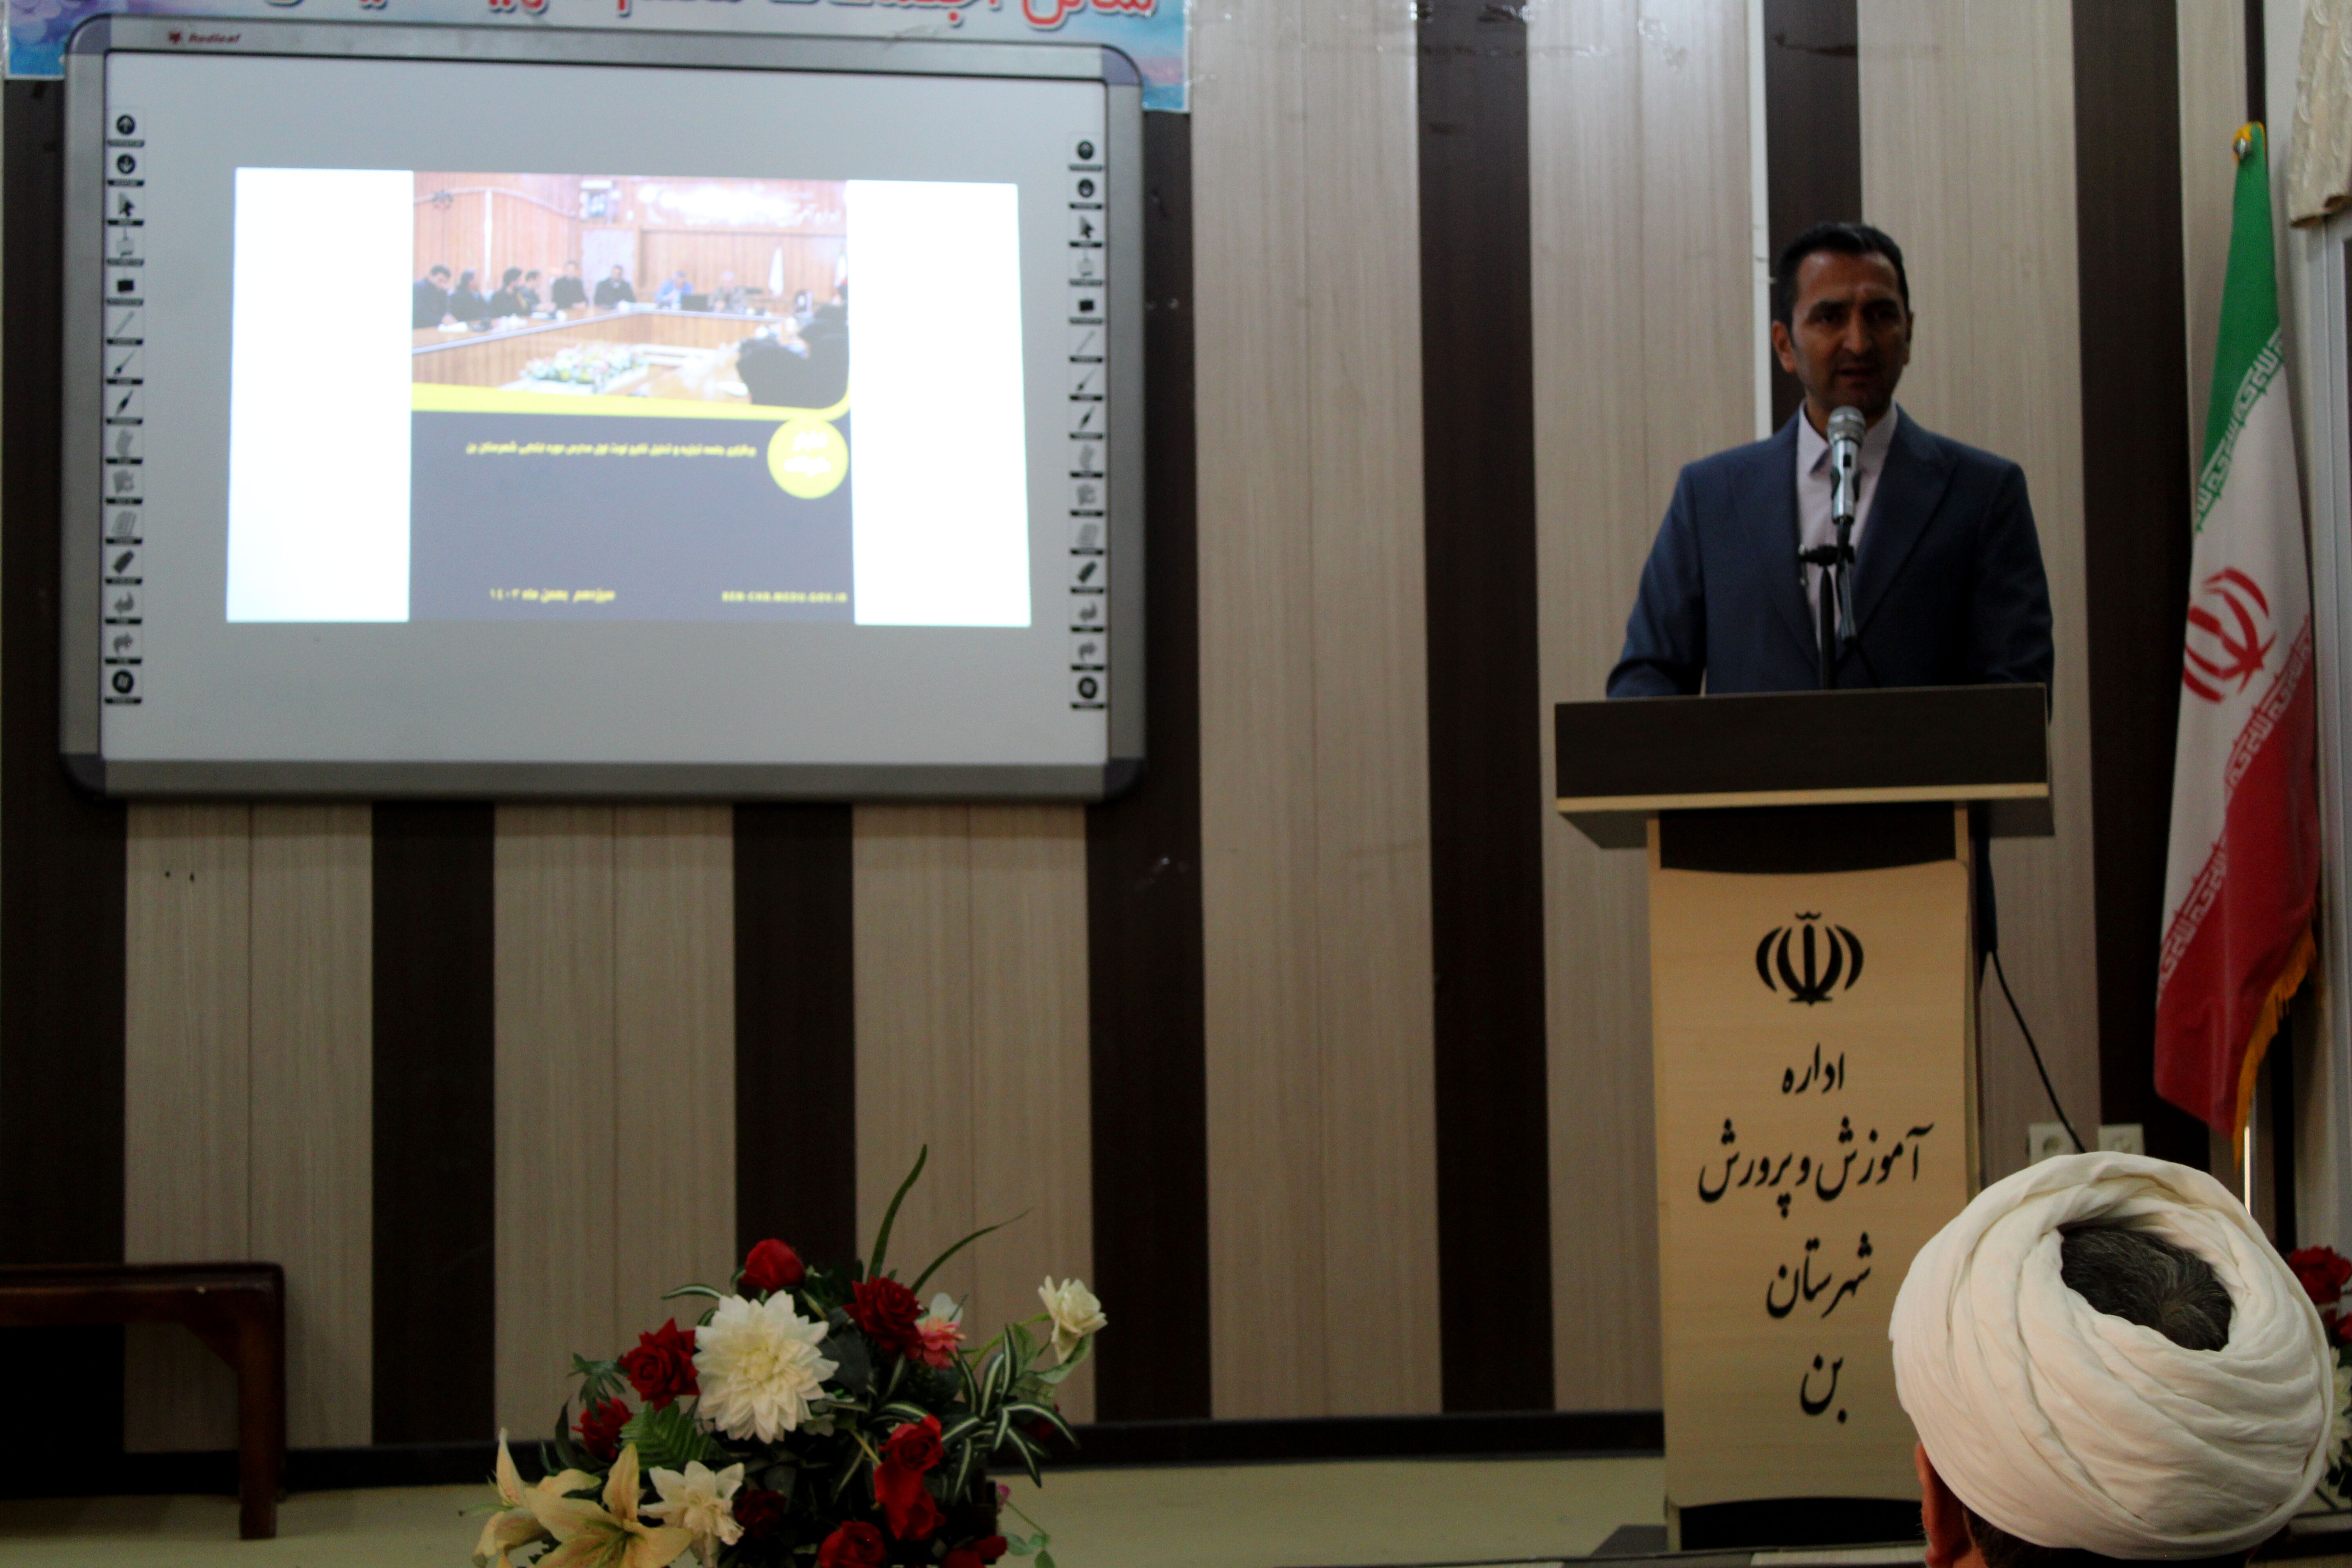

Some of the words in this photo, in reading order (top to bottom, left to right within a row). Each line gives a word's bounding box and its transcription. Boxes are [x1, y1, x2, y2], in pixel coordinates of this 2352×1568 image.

[1781, 1043, 1846, 1095] اداره
[1697, 1118, 1793, 1220] پرورش
[1815, 1115, 1935, 1203] آموزش
[1765, 1231, 1873, 1321] شهرستان
[1798, 1353, 1849, 1426] بن
